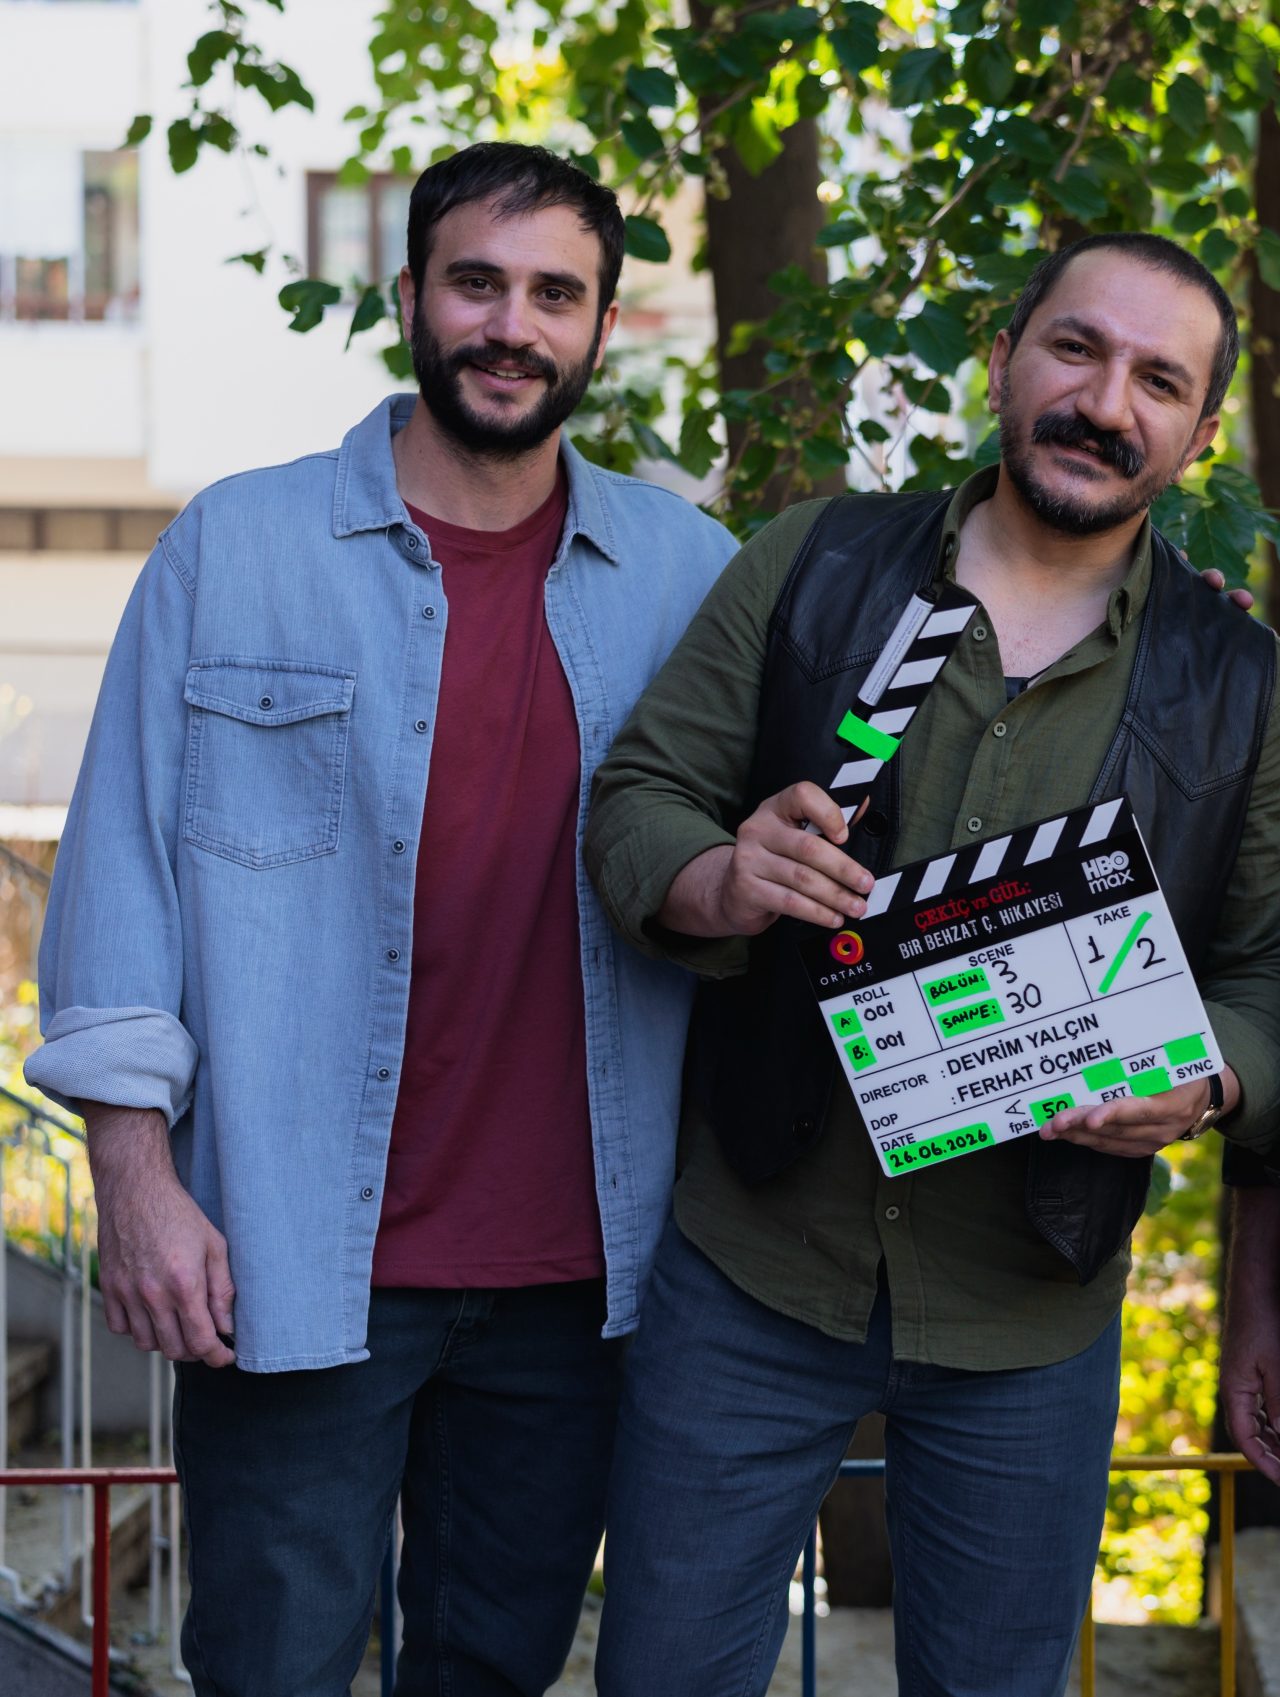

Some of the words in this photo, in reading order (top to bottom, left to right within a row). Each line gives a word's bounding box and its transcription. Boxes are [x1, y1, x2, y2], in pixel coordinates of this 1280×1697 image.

[1081, 850, 1130, 881] HBO
[1088, 869, 1135, 895] max
[914, 898, 970, 933] ÇEKİÇ
[989, 880, 1032, 905] GÜL:
[1094, 905, 1132, 926] TAKE
[925, 918, 979, 951] BEHZAT
[981, 916, 998, 935] Ç.
[968, 943, 1016, 967] SCENE
[820, 962, 873, 986] ORTAKS
[991, 960, 1018, 984] 3
[852, 986, 890, 1006] ROLL
[942, 1003, 998, 1029] SAHNE:
[1006, 982, 1042, 1015] 30
[863, 1001, 896, 1022] 001
[851, 1043, 869, 1061] B:
[876, 1030, 906, 1051] 001
[860, 1073, 929, 1104] DIRECTOR
[1025, 1012, 1100, 1049] YALÇIN
[1129, 1054, 1158, 1073] DAY
[1176, 1058, 1215, 1080] SYNC
[870, 1113, 899, 1132] DOP
[956, 1063, 1034, 1103] FERHAT
[1039, 1038, 1114, 1075] ÖÇMEN
[1100, 1086, 1128, 1103] EXT
[1008, 1118, 1035, 1135] fps:
[879, 1132, 916, 1152] DATE
[889, 1128, 988, 1168] 26.06.2026
